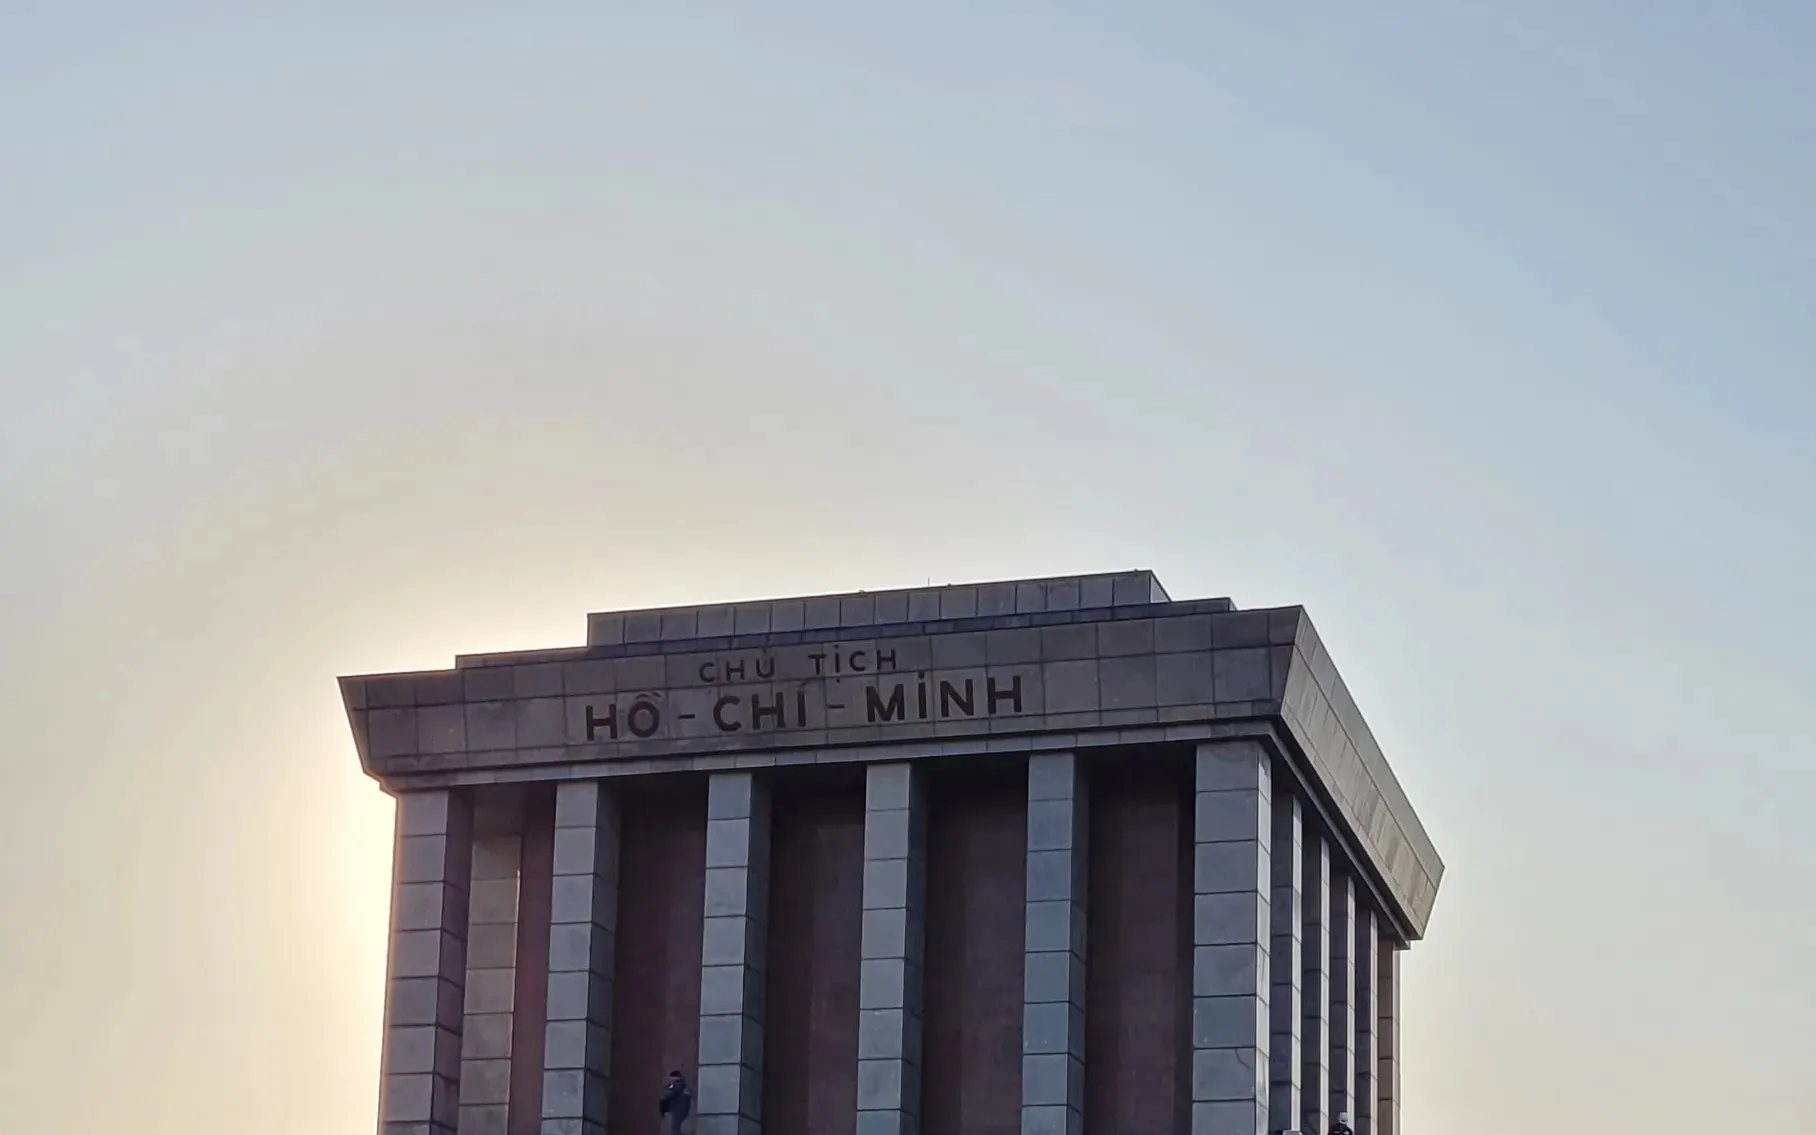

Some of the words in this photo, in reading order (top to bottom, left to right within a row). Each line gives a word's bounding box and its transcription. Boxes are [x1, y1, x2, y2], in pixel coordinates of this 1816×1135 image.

[807, 643, 897, 684] TỊCH
[585, 691, 662, 742] HỒ
[712, 681, 808, 732] CHÍ
